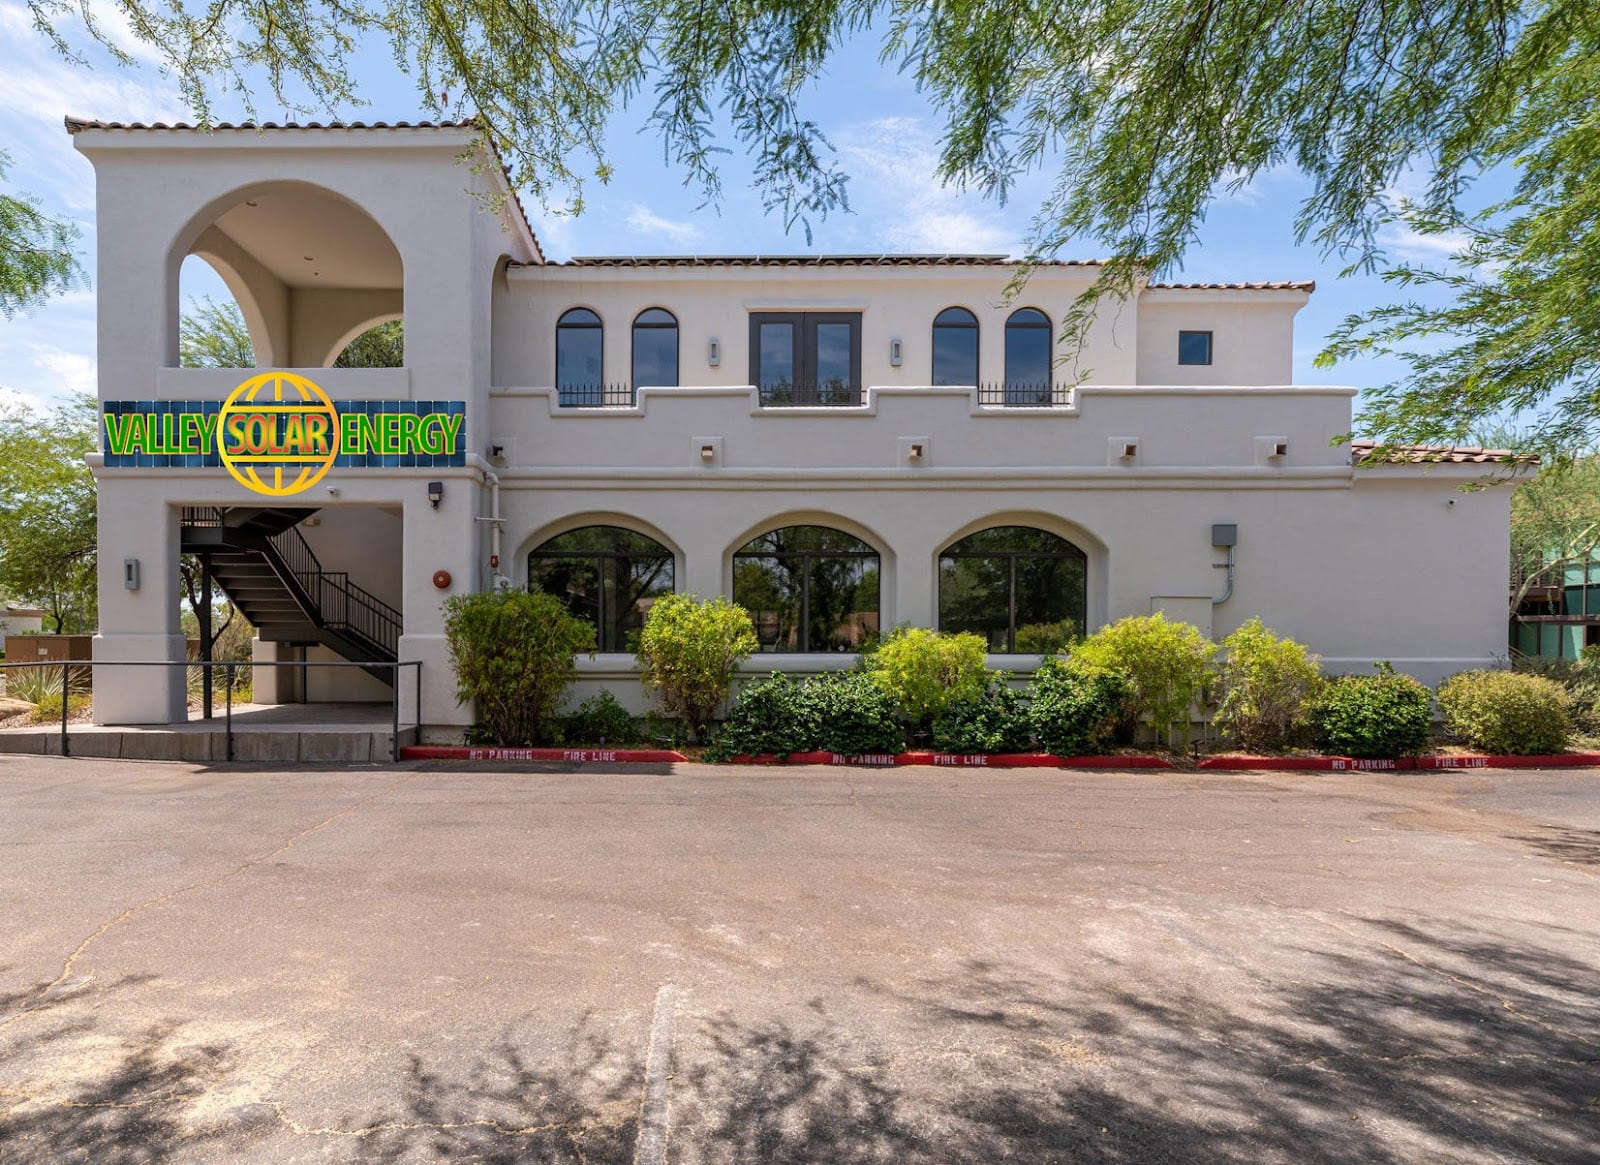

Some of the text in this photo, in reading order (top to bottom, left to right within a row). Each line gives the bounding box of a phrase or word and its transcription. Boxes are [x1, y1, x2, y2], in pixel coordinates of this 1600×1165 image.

[104, 413, 464, 456] VALLEY SOLAR ENERGY
[469, 750, 533, 760] NO PARKING
[563, 751, 616, 761] FIRE LINE
[851, 754, 895, 765] PARKING
[934, 754, 988, 765] FIRE LINE
[1332, 759, 1396, 769] NO PARKING
[1435, 758, 1489, 768] FIRE LINE
